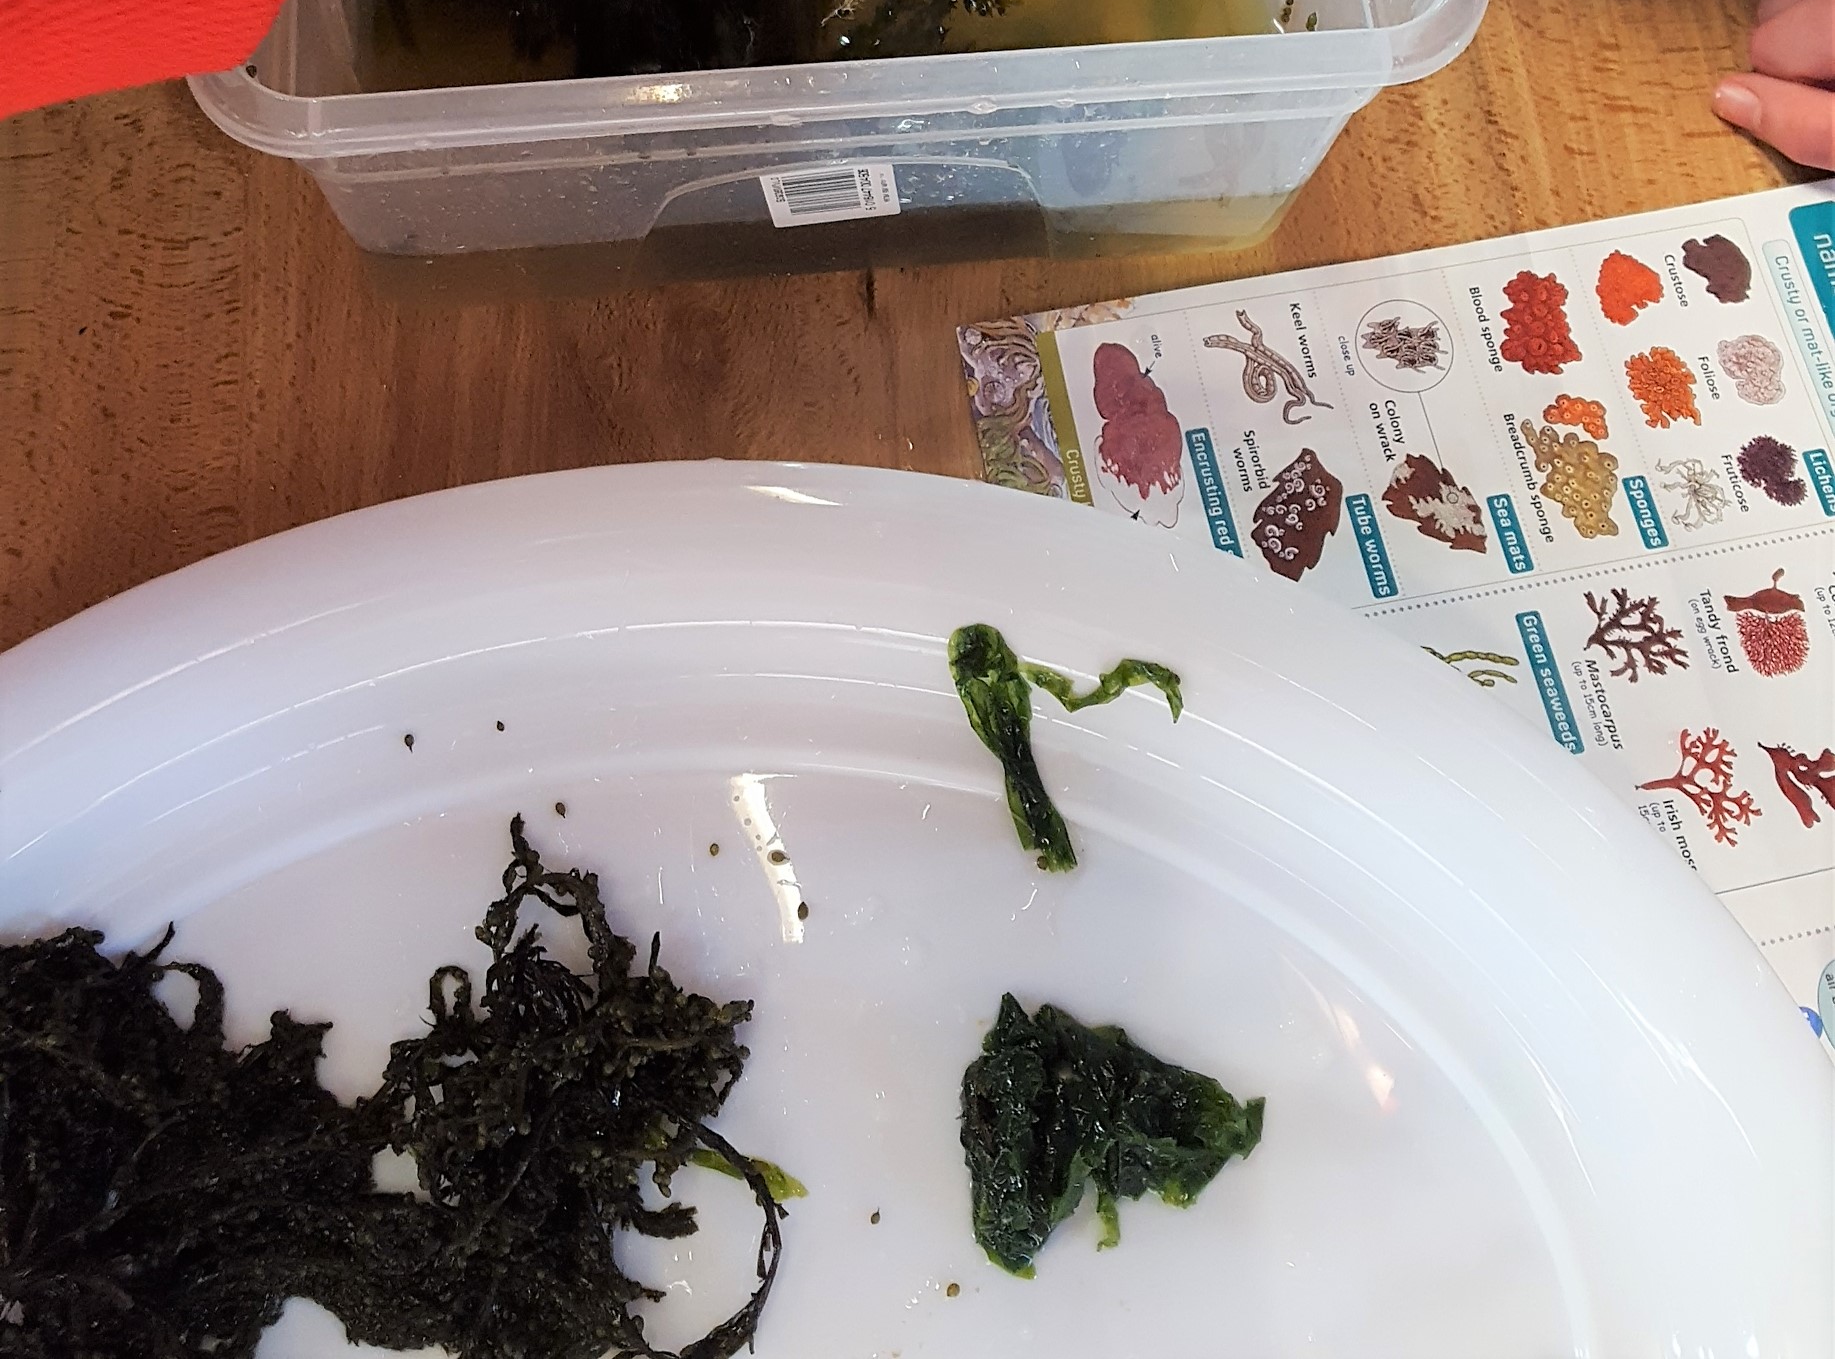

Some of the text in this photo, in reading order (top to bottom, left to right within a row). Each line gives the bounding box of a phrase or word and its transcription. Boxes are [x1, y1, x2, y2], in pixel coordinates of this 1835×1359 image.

[1664, 254, 1689, 308] Crustose
[1151, 334, 1163, 358] alive
[1289, 302, 1317, 379] Keel worms
[1469, 286, 1503, 372] Blood sponge
[1775, 255, 1801, 304] Crusty
[1795, 309, 1809, 323] or
[1802, 327, 1833, 389] mat-like
[1338, 335, 1355, 377] close up
[1697, 356, 1720, 400] Foliose
[1369, 402, 1395, 461] on wrack
[1384, 399, 1405, 445] Colony
[1066, 449, 1086, 499] Crusty
[1192, 432, 1222, 516] Encrusting
[1215, 514, 1234, 546] red
[1233, 447, 1252, 493] worms
[1244, 429, 1271, 490] Spirorbid
[1503, 413, 1554, 543] Breadcrumb sponge
[1721, 454, 1750, 513] Fruticose
[1494, 497, 1526, 571] Sea mats
[1630, 478, 1661, 547] Sponges
[1352, 497, 1390, 597] Tube worms
[1700, 588, 1739, 673] Tandy frond
[1814, 587, 1826, 602] (up
[1823, 604, 1831, 615] to
[1688, 599, 1721, 669] (on egg wrack)
[1523, 615, 1578, 752] Green seaweeds
[1571, 661, 1609, 747] (up to 15cm long)
[1585, 659, 1624, 750] Mastocarpus
[1649, 802, 1667, 832] (up to
[1663, 799, 1682, 831] Irish
